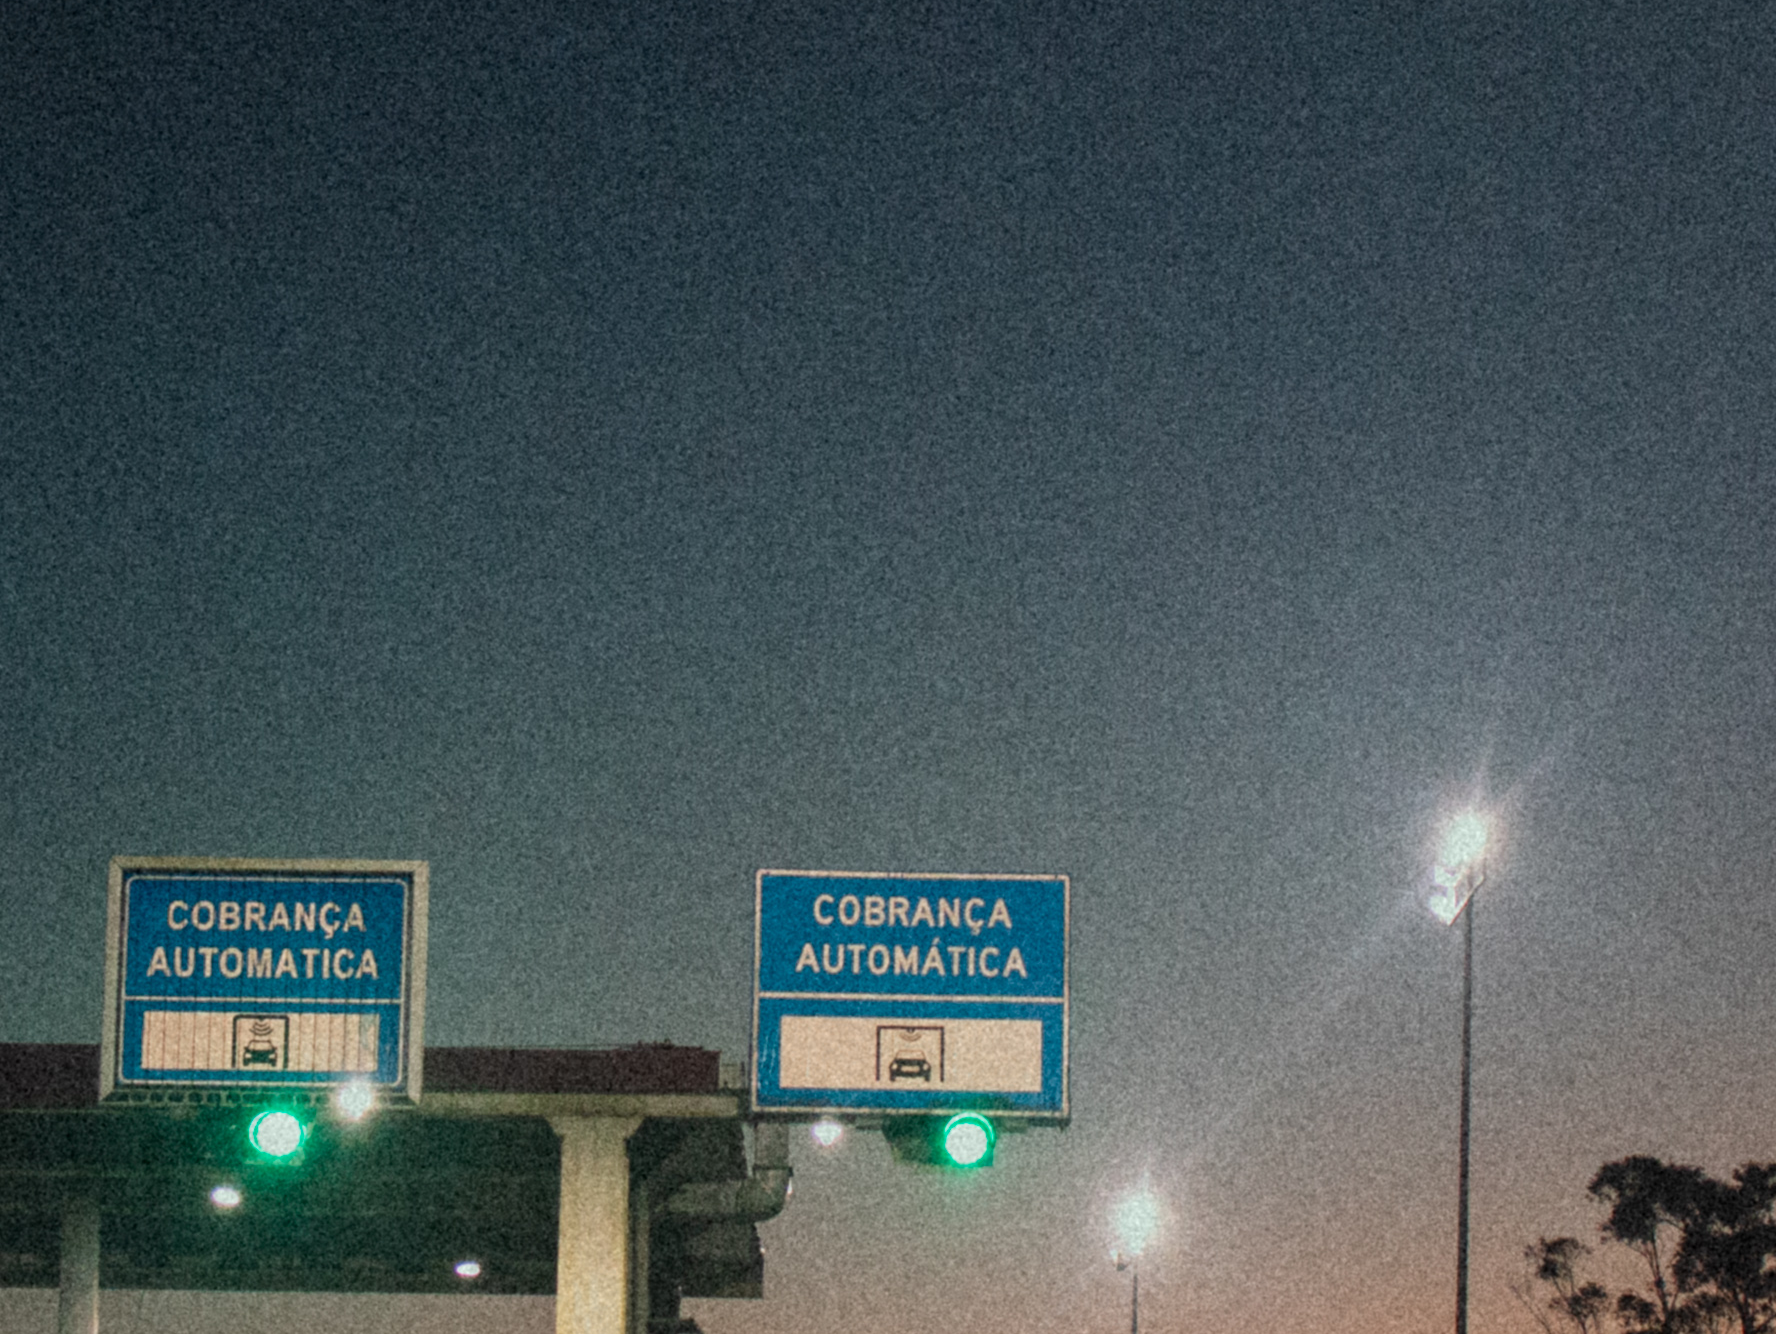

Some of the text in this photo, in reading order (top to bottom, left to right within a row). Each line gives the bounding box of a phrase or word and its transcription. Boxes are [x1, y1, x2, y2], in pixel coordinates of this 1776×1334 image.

[167, 900, 366, 939] COBRANÇA
[813, 893, 1012, 936] COBRANÇA
[146, 946, 379, 980] AUTOMATICA
[795, 936, 1028, 977] AUTOMÁTICA
